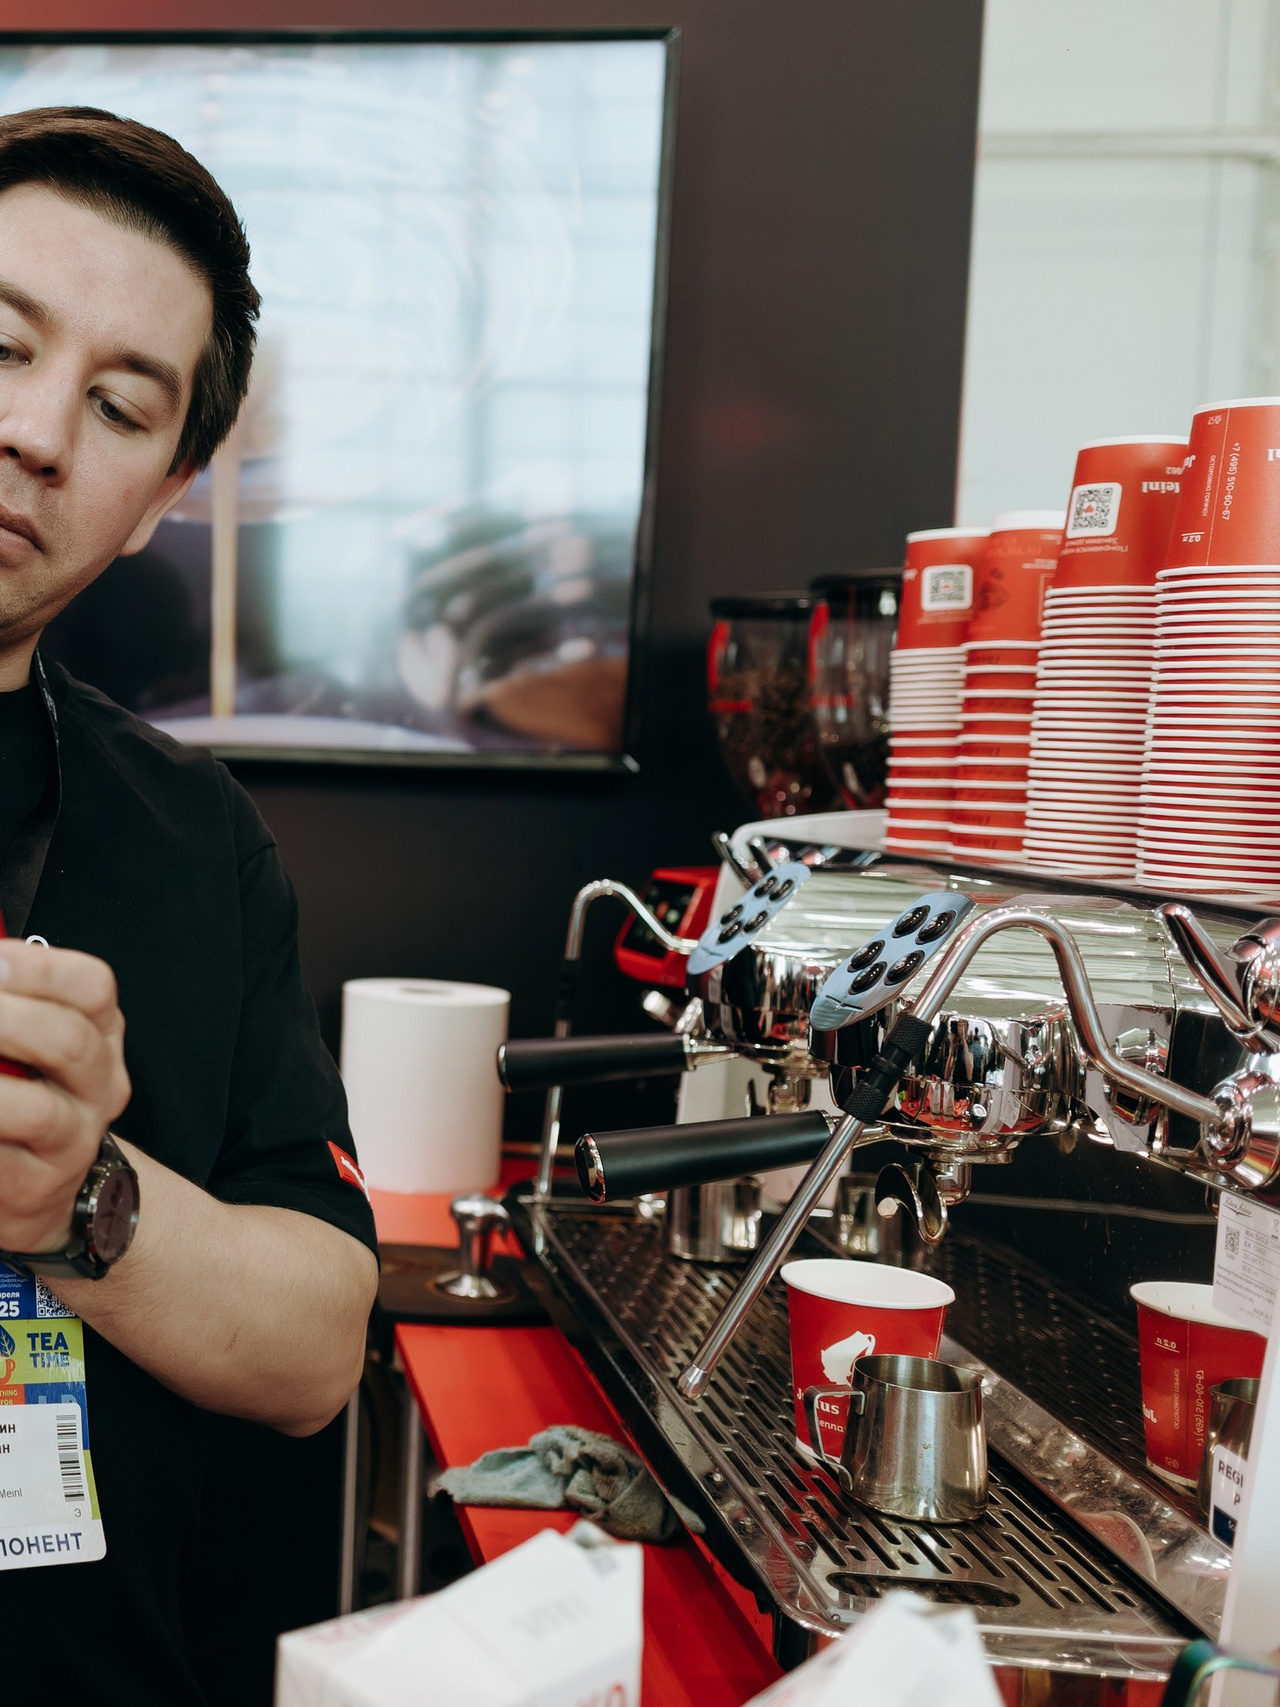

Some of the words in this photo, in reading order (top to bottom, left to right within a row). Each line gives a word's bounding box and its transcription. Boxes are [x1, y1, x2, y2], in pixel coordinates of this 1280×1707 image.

[1227, 453, 1240, 475] (495)
[1222, 477, 1236, 520] 510-60-67
[27, 1332, 69, 1351] TEA
[29, 1352, 70, 1368] TIME
[819, 1419, 844, 1433] enna
